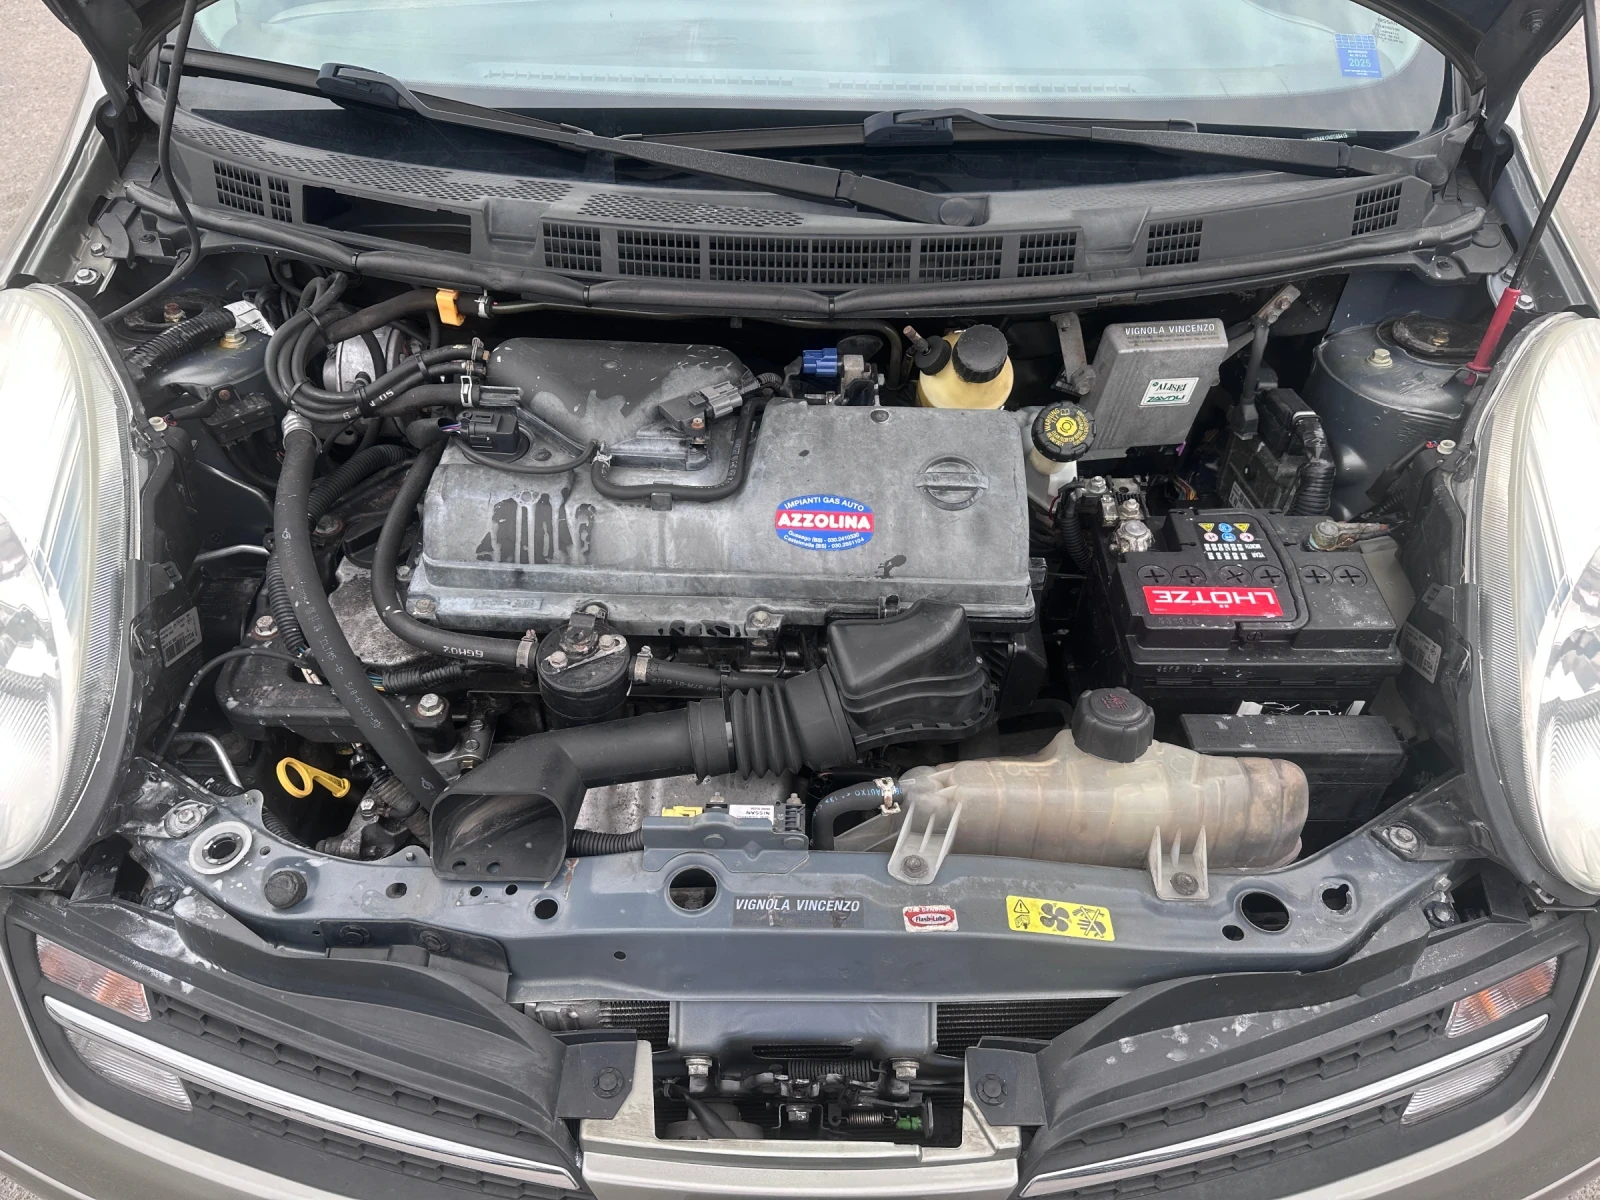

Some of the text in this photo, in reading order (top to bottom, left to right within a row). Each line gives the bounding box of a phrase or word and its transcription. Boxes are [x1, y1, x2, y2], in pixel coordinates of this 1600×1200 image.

[1348, 58, 1372, 68] 2025
[1125, 324, 1215, 336] VIGNOLA VINCENZO
[784, 496, 864, 512] IMPIANTI GAS AUTO
[778, 512, 870, 530] AZZOLINA
[1152, 590, 1275, 608] LHÖTZE
[736, 898, 860, 912] VIGNOLA VINCENZO
